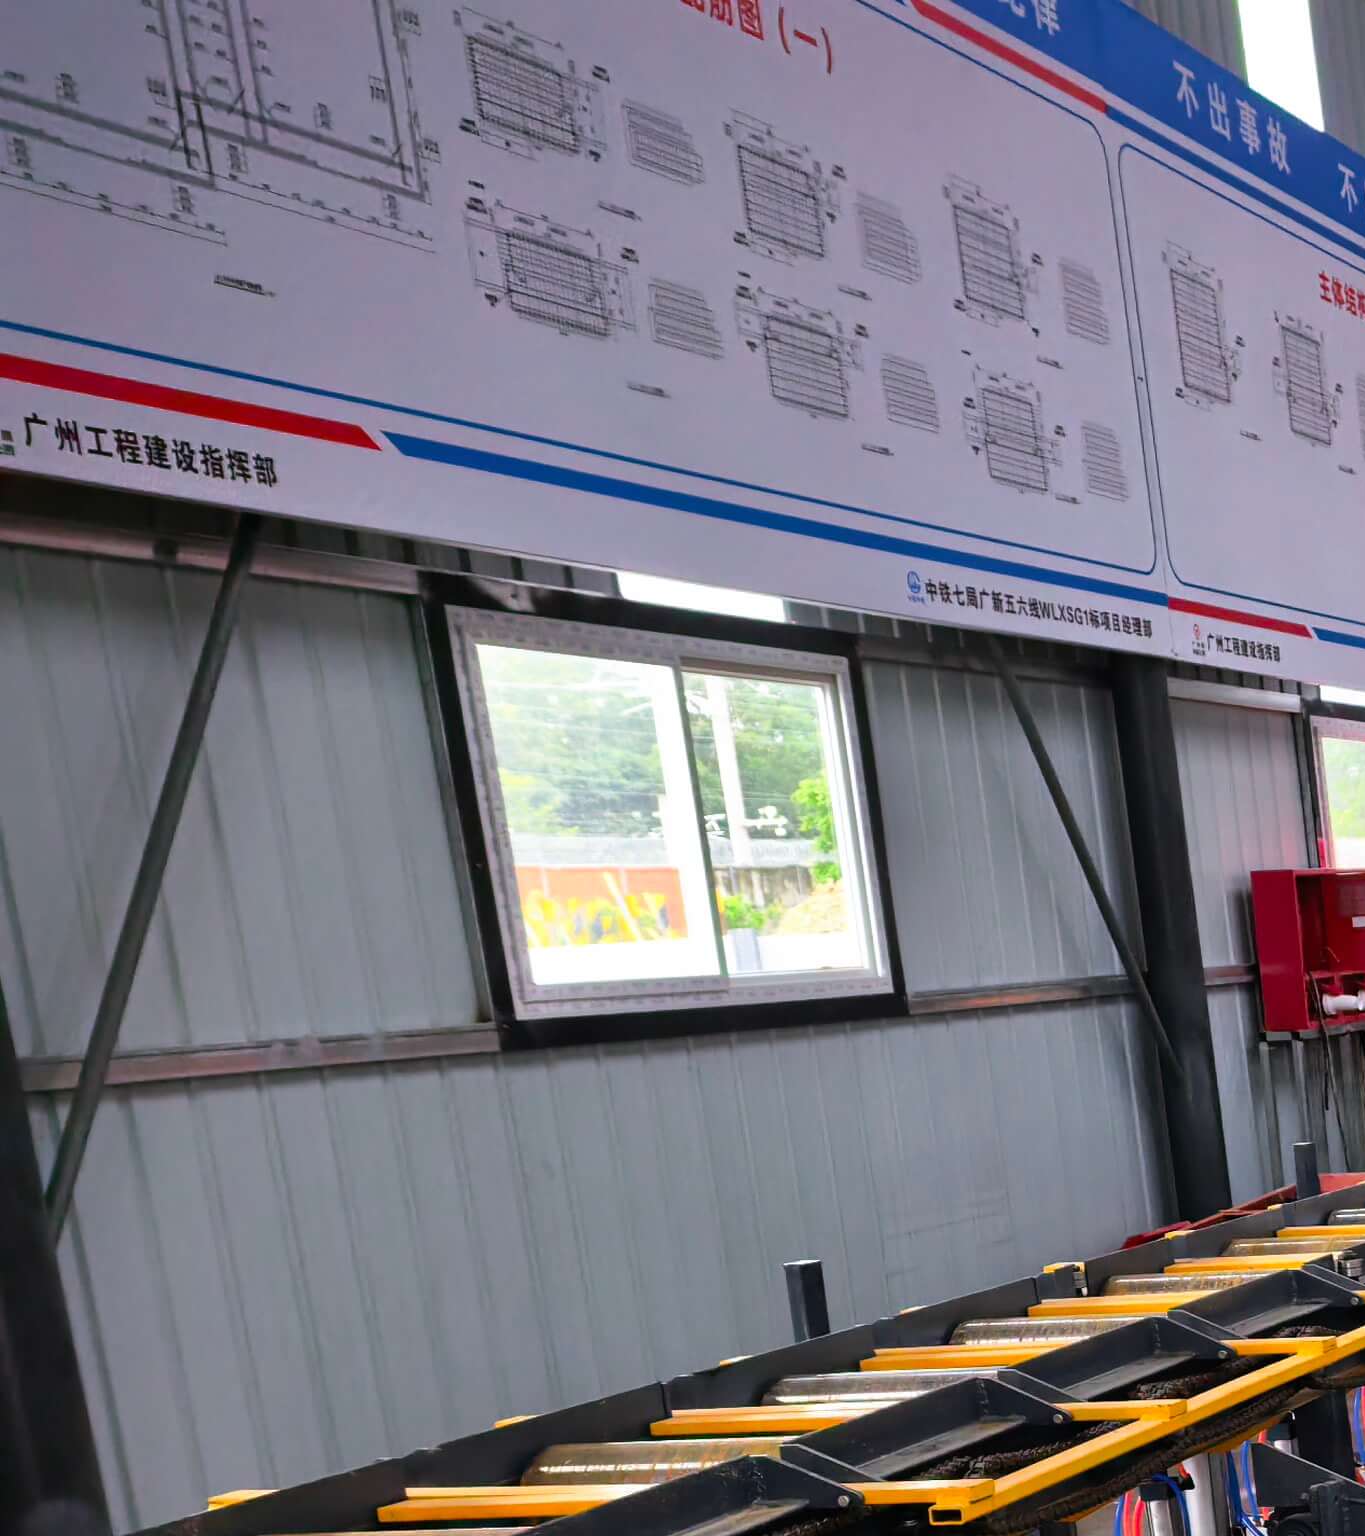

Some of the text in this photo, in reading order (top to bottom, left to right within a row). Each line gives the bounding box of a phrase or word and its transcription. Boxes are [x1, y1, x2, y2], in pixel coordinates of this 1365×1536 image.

[1172, 60, 1291, 174] 不出事故
[23, 412, 279, 488] 广州工程建设指挥部
